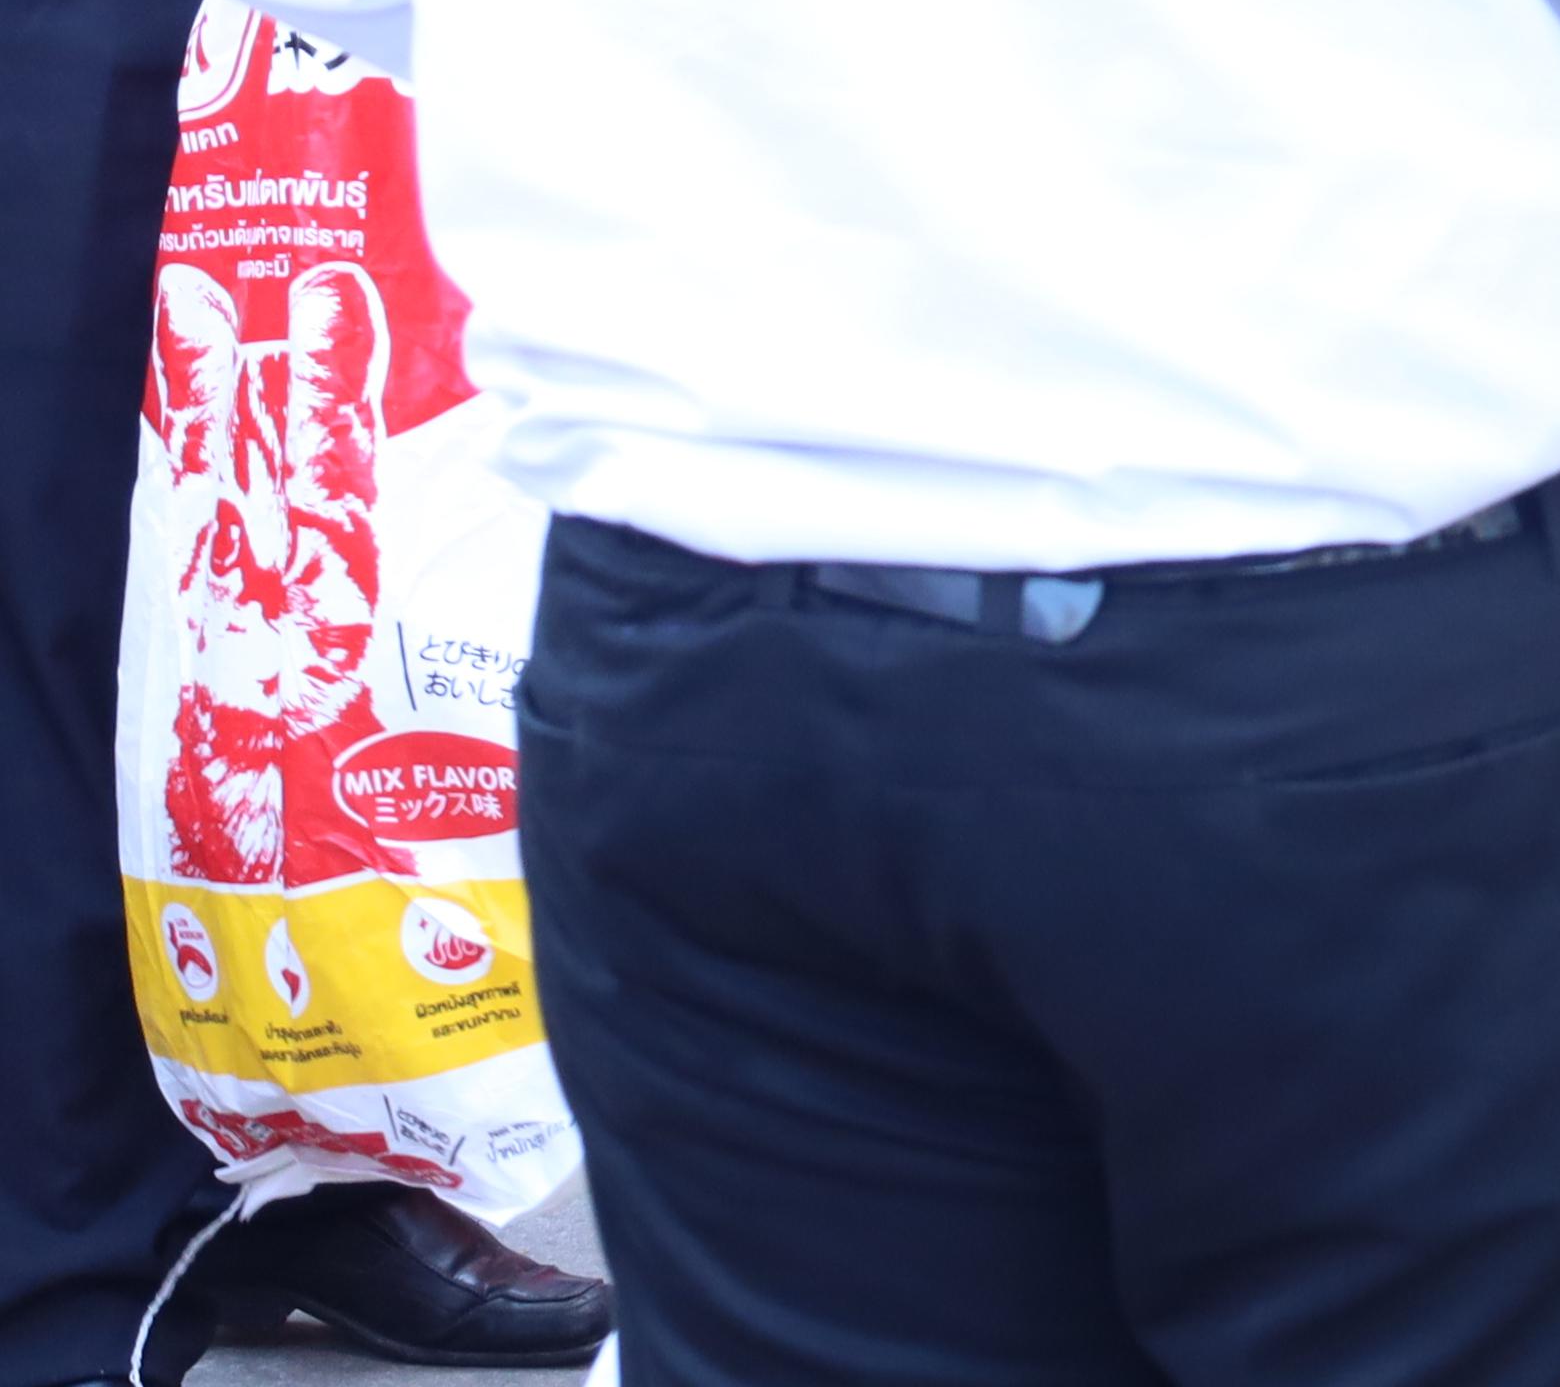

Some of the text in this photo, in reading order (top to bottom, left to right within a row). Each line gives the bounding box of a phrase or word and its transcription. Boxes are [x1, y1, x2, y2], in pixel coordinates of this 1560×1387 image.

[345, 764, 518, 797] MIX FLAVOR
[374, 790, 504, 824] ミックス味
